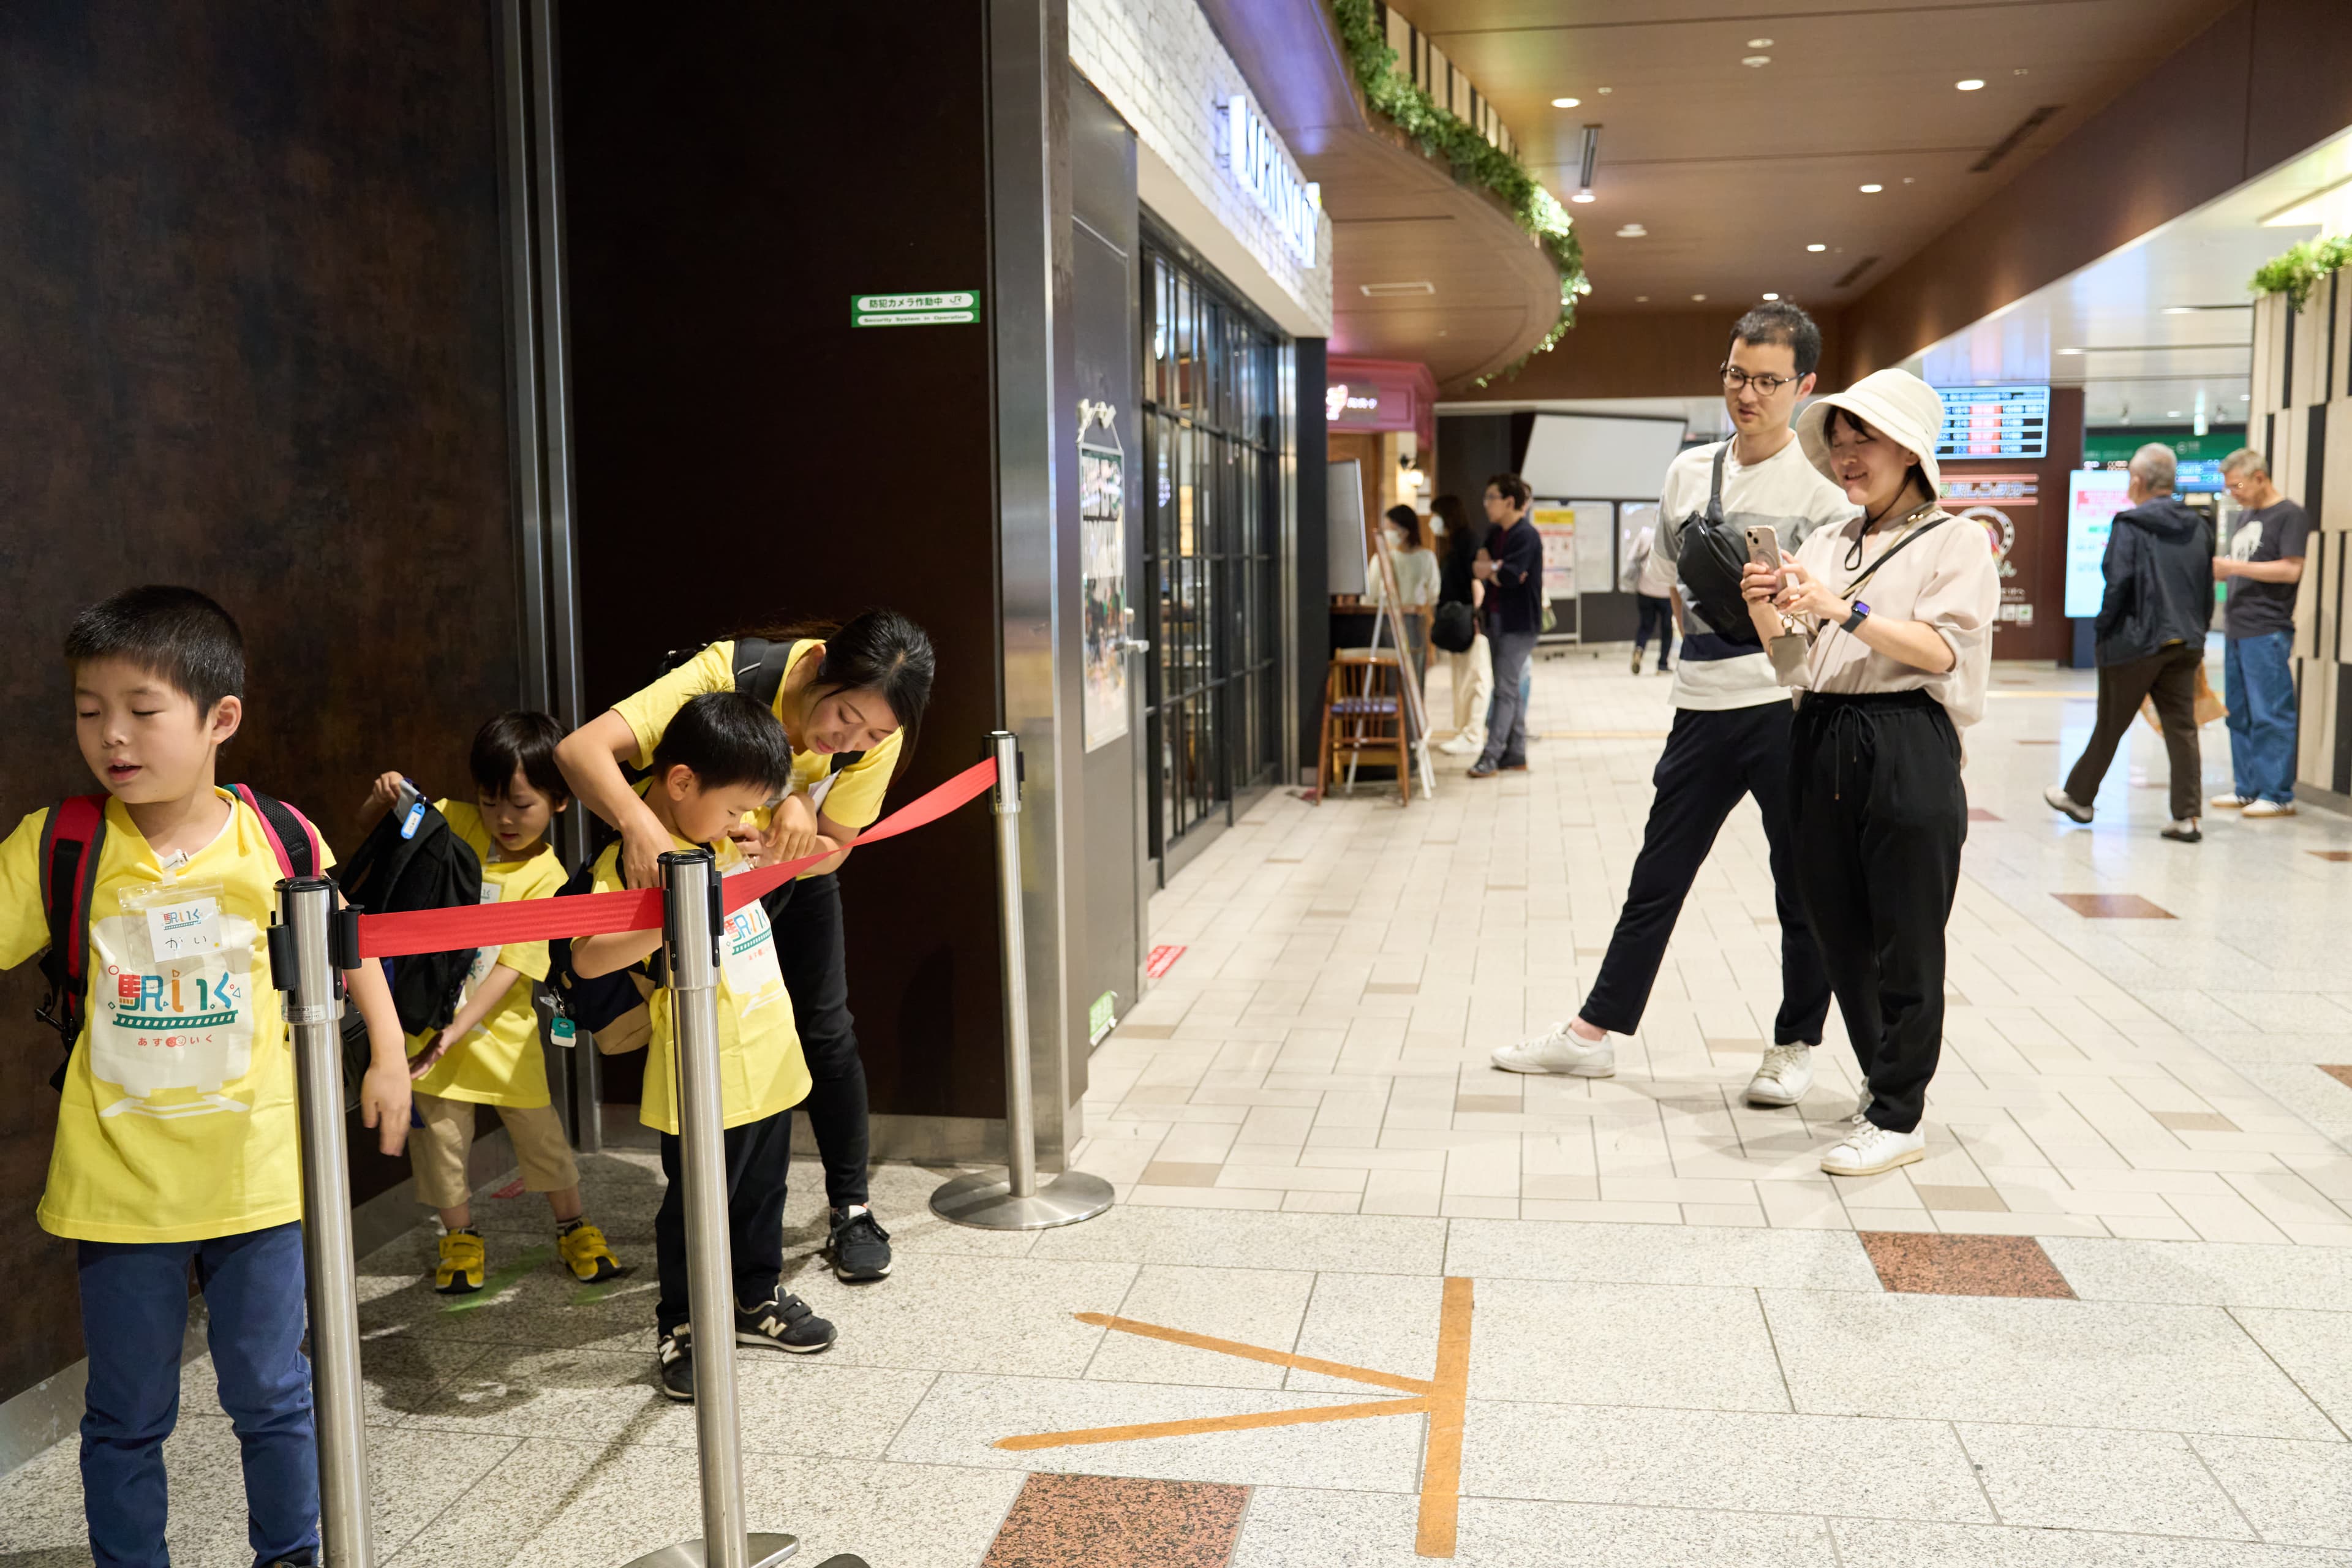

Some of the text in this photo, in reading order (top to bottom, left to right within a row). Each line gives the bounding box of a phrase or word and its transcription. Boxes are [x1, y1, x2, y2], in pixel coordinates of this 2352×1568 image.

[869, 298, 943, 308] 防犯カメラ作動中
[759, 1316, 788, 1338] N
[659, 1338, 681, 1363] N
